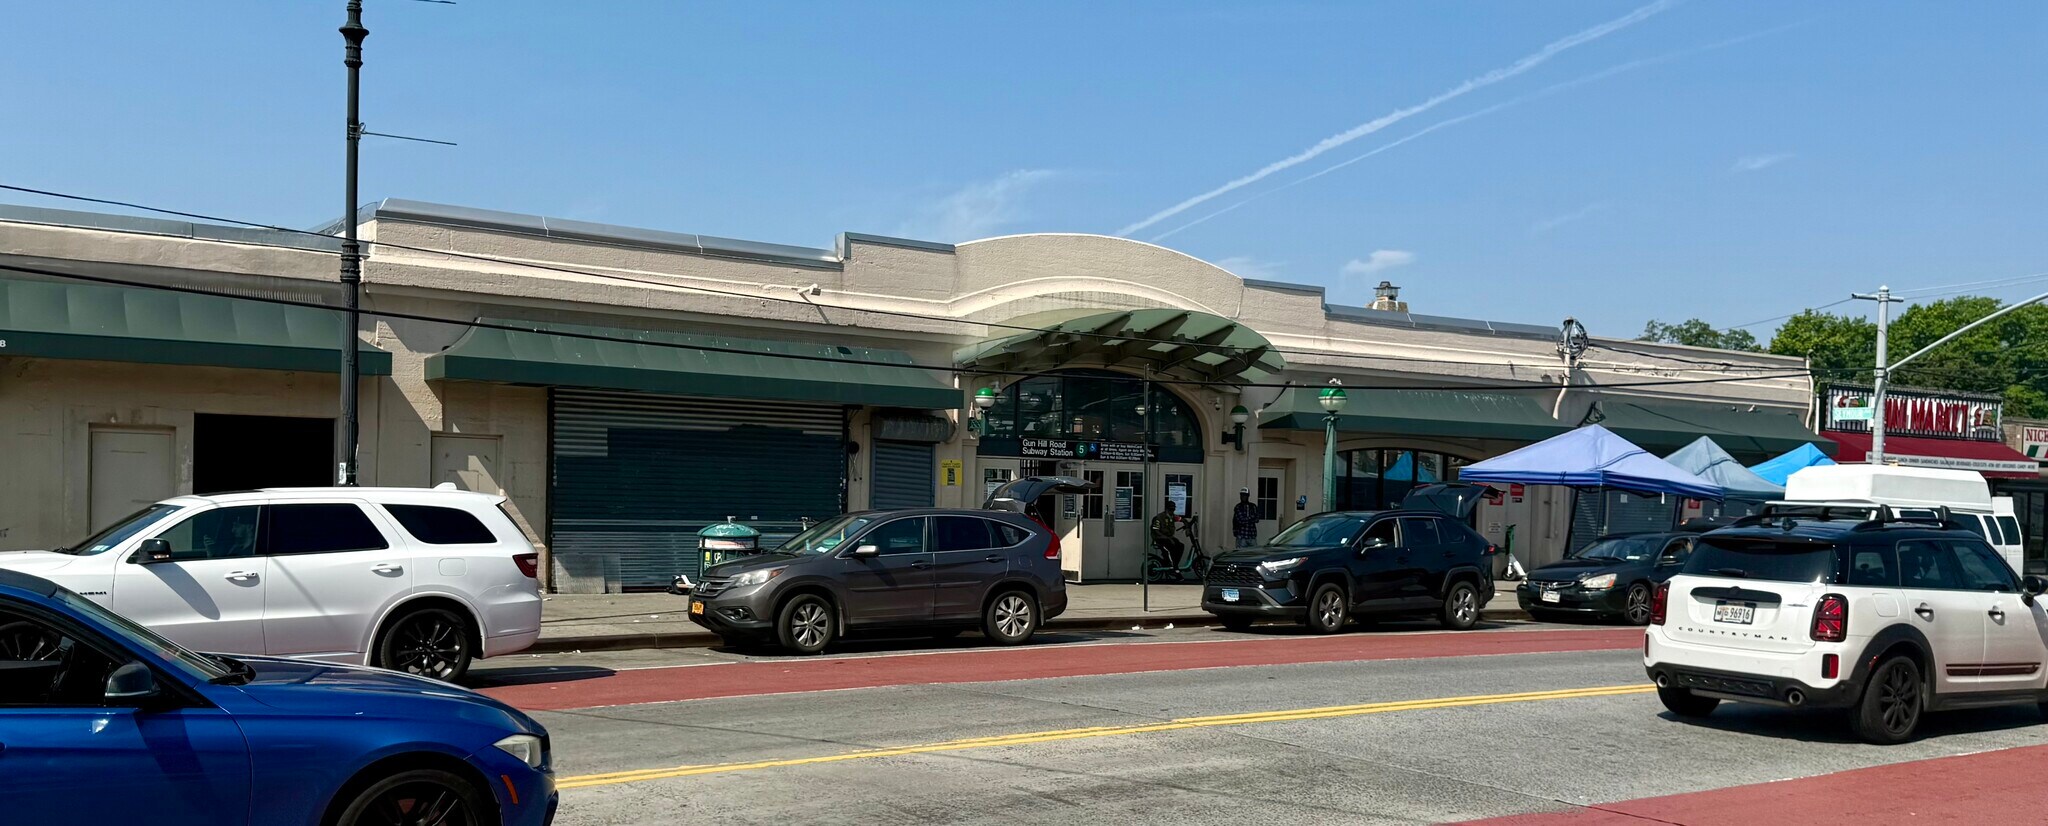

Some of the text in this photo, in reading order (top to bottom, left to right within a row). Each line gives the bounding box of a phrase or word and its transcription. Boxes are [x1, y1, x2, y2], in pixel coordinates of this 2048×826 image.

[1910, 399, 1969, 433] MARKET
[1022, 439, 1067, 449] Gun Hill Road
[1079, 445, 1084, 454] 5
[1022, 447, 1074, 457] Subway Station
[1729, 607, 1751, 620] 96916
[1678, 626, 1788, 641] COUNTRYMAN
